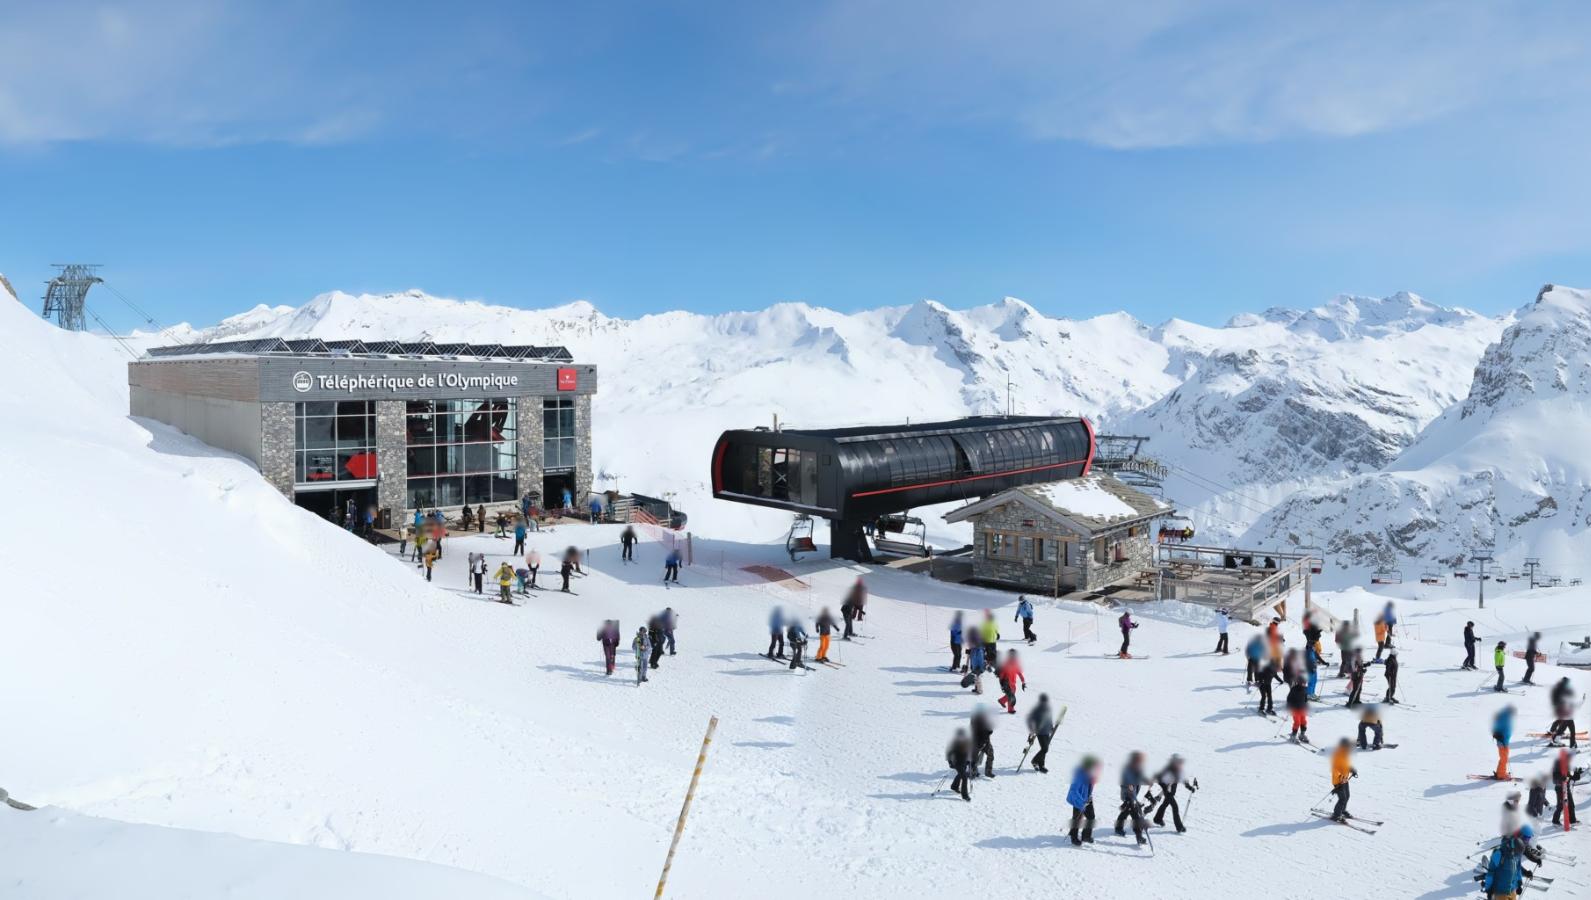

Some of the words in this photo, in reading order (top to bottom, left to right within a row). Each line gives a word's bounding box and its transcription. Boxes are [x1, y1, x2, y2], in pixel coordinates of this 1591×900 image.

[317, 374, 414, 392] Téléphérique
[418, 374, 434, 388] de
[438, 373, 518, 391] l'Olympique
